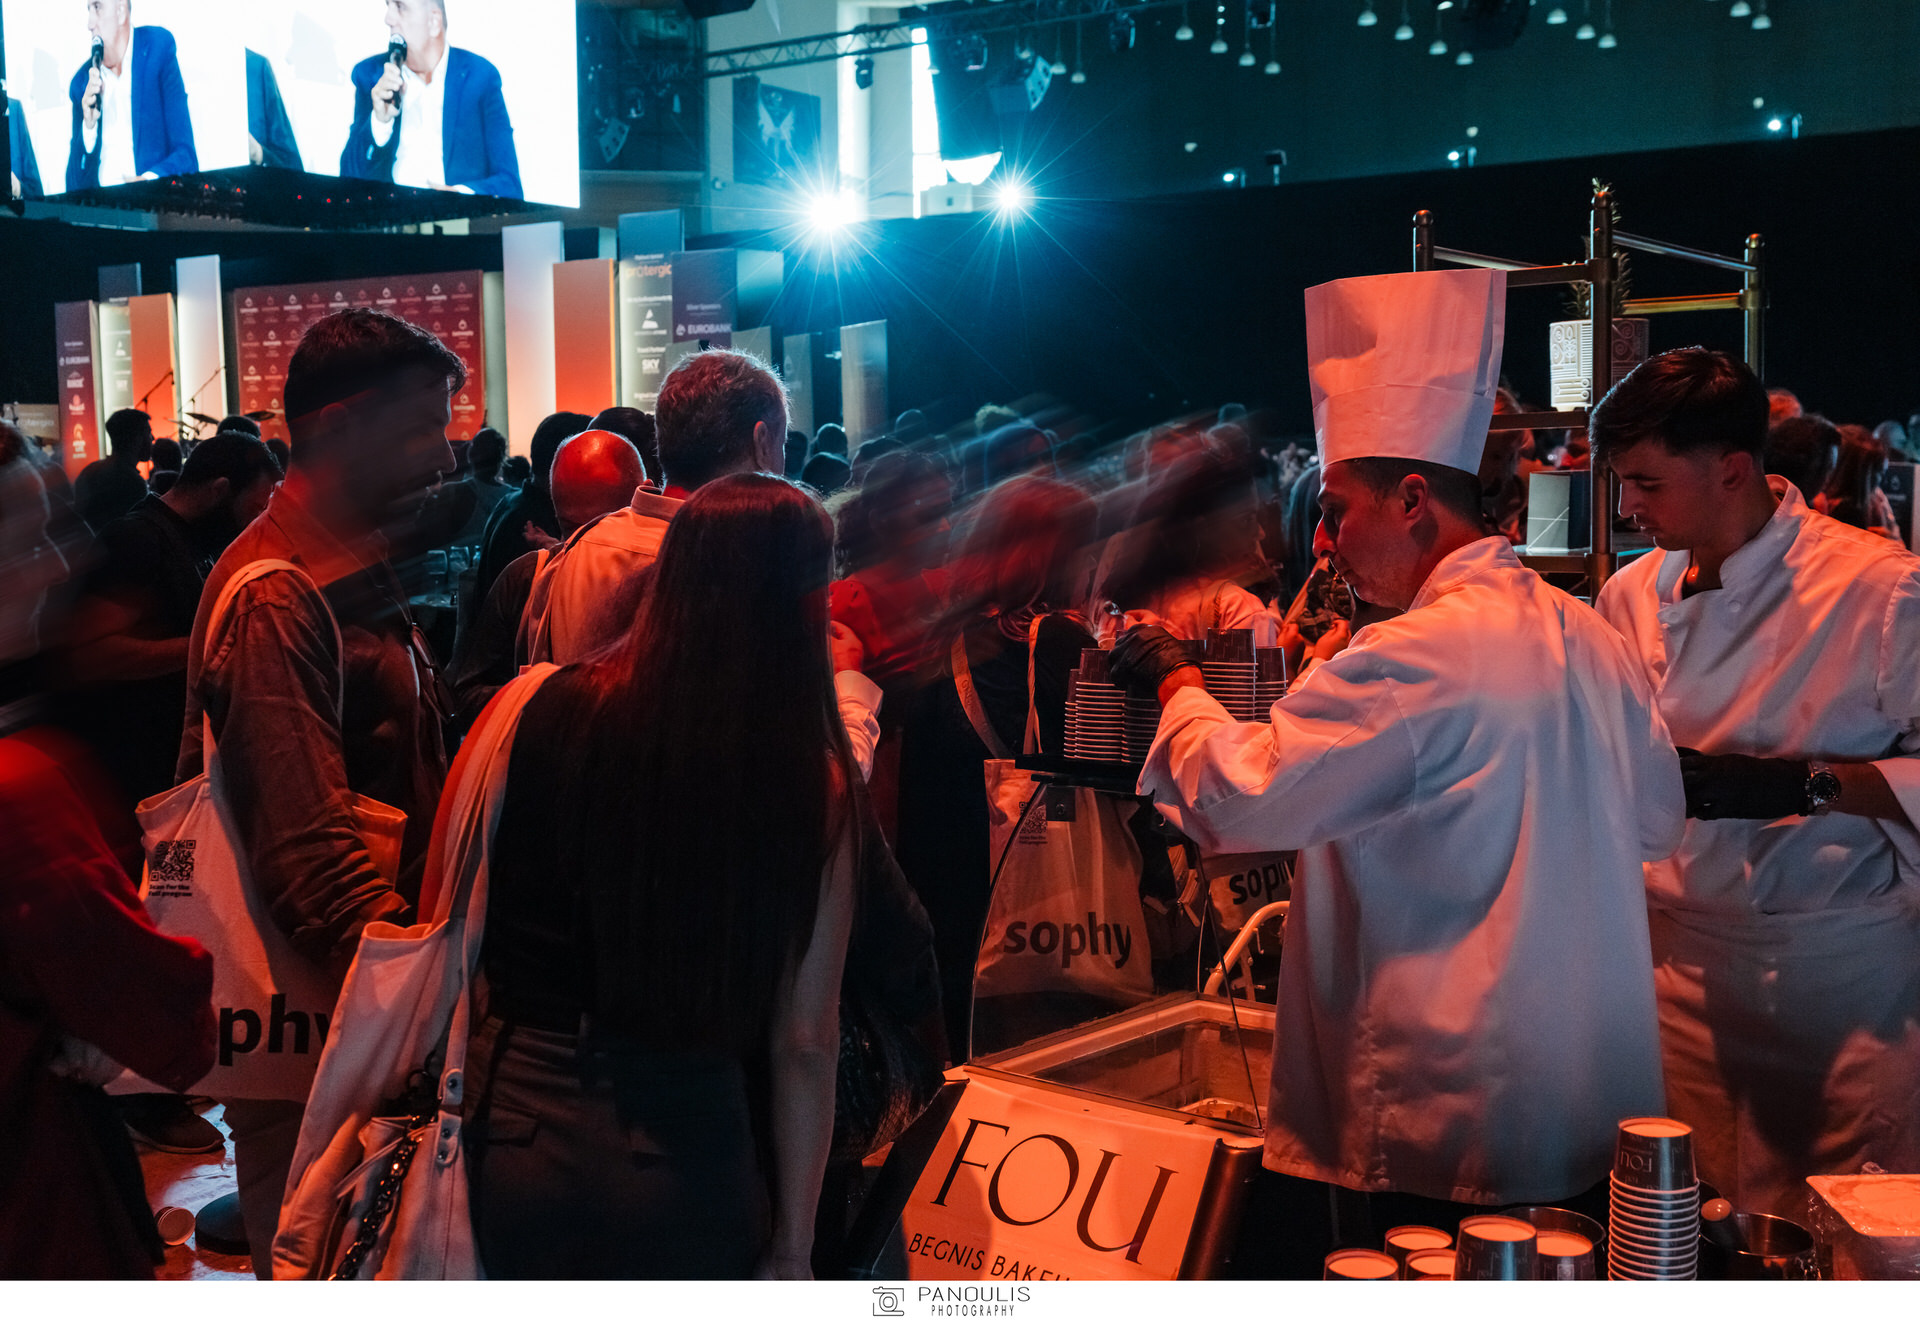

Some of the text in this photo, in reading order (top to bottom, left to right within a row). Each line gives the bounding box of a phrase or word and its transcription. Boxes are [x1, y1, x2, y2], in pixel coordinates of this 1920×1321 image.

[688, 323, 732, 334] EUROBANK
[642, 359, 660, 370] SKY
[1003, 912, 1131, 969] sophy
[930, 1118, 1179, 1265] FOU
[909, 1233, 985, 1271] BEGNIS
